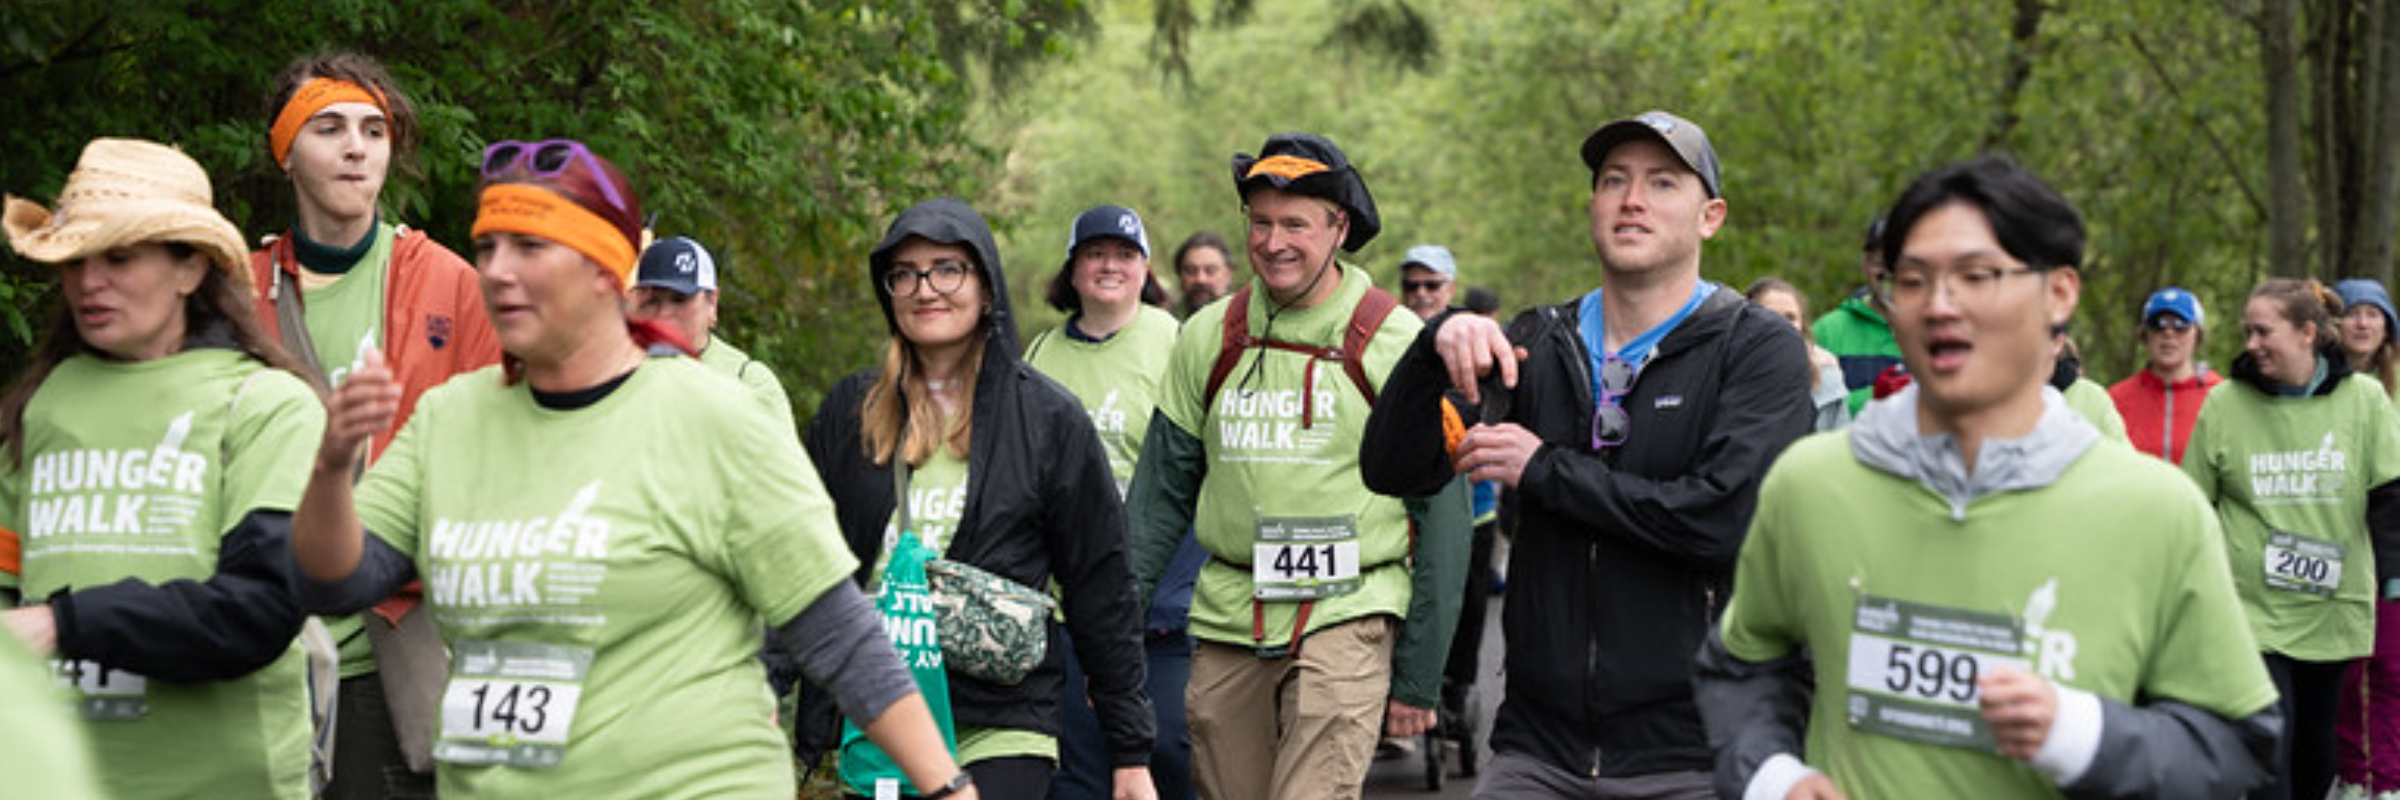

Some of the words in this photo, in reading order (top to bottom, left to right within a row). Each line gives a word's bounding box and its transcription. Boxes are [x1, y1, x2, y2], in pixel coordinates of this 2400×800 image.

[1220, 420, 1297, 449] WALK
[29, 443, 208, 496] HUNGER
[2250, 448, 2346, 474] HUNGER
[908, 485, 967, 521] NGE
[2251, 473, 2318, 496] WALK
[28, 495, 148, 540] WALK
[430, 514, 608, 560] HUNGER
[1273, 545, 1335, 578] 441
[2277, 551, 2329, 581] 200
[431, 562, 544, 608] WALK
[1886, 644, 1980, 703] 599
[472, 682, 553, 735] 143
